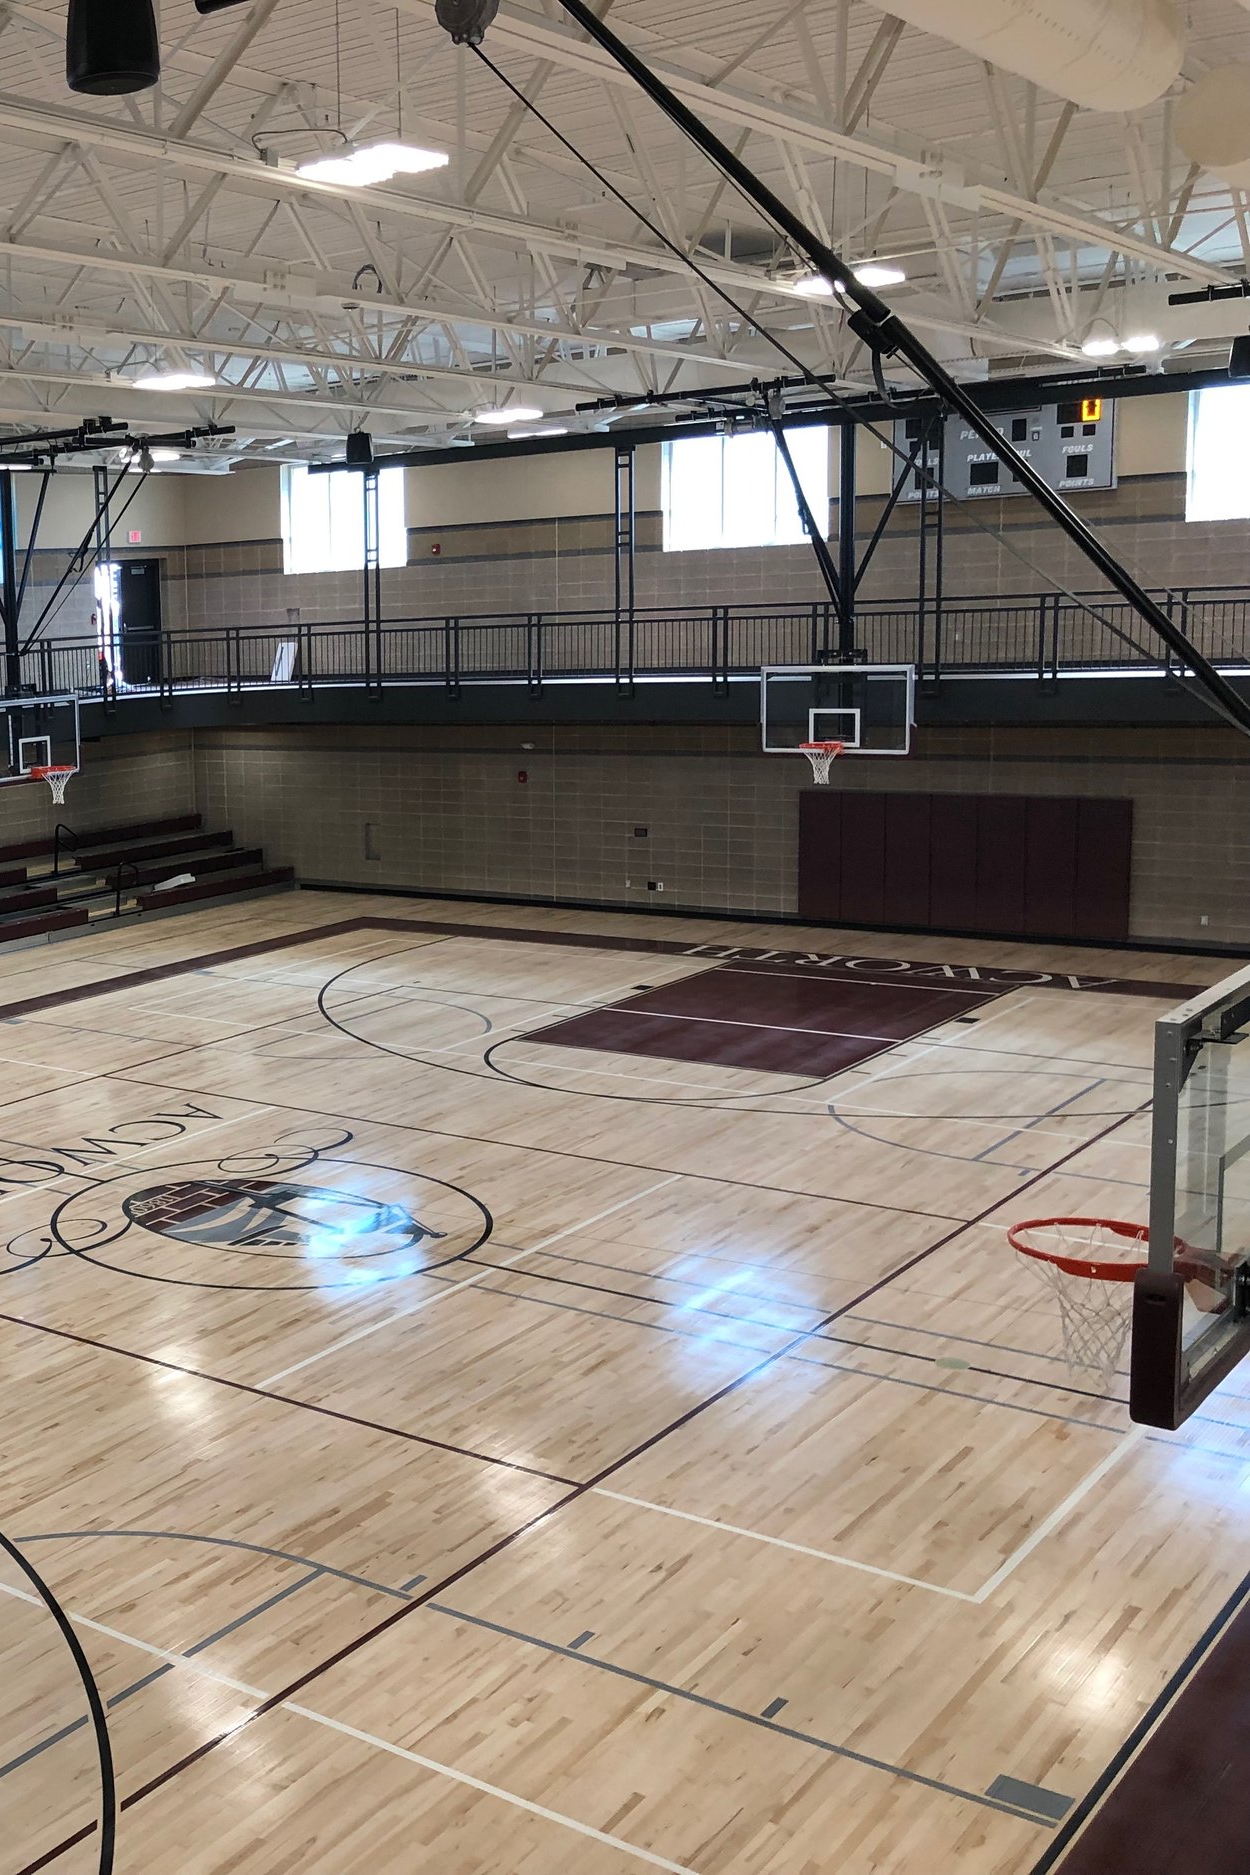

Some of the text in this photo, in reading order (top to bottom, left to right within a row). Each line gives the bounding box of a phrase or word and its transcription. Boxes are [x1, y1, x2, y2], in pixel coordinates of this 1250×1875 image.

[960, 427, 1004, 440] PED
[1062, 444, 1094, 454] FOULS
[967, 452, 1000, 462] PLAYE
[1059, 478, 1095, 488] POINTS
[967, 485, 1001, 496] MATCH
[679, 944, 1119, 989] ACWORTH
